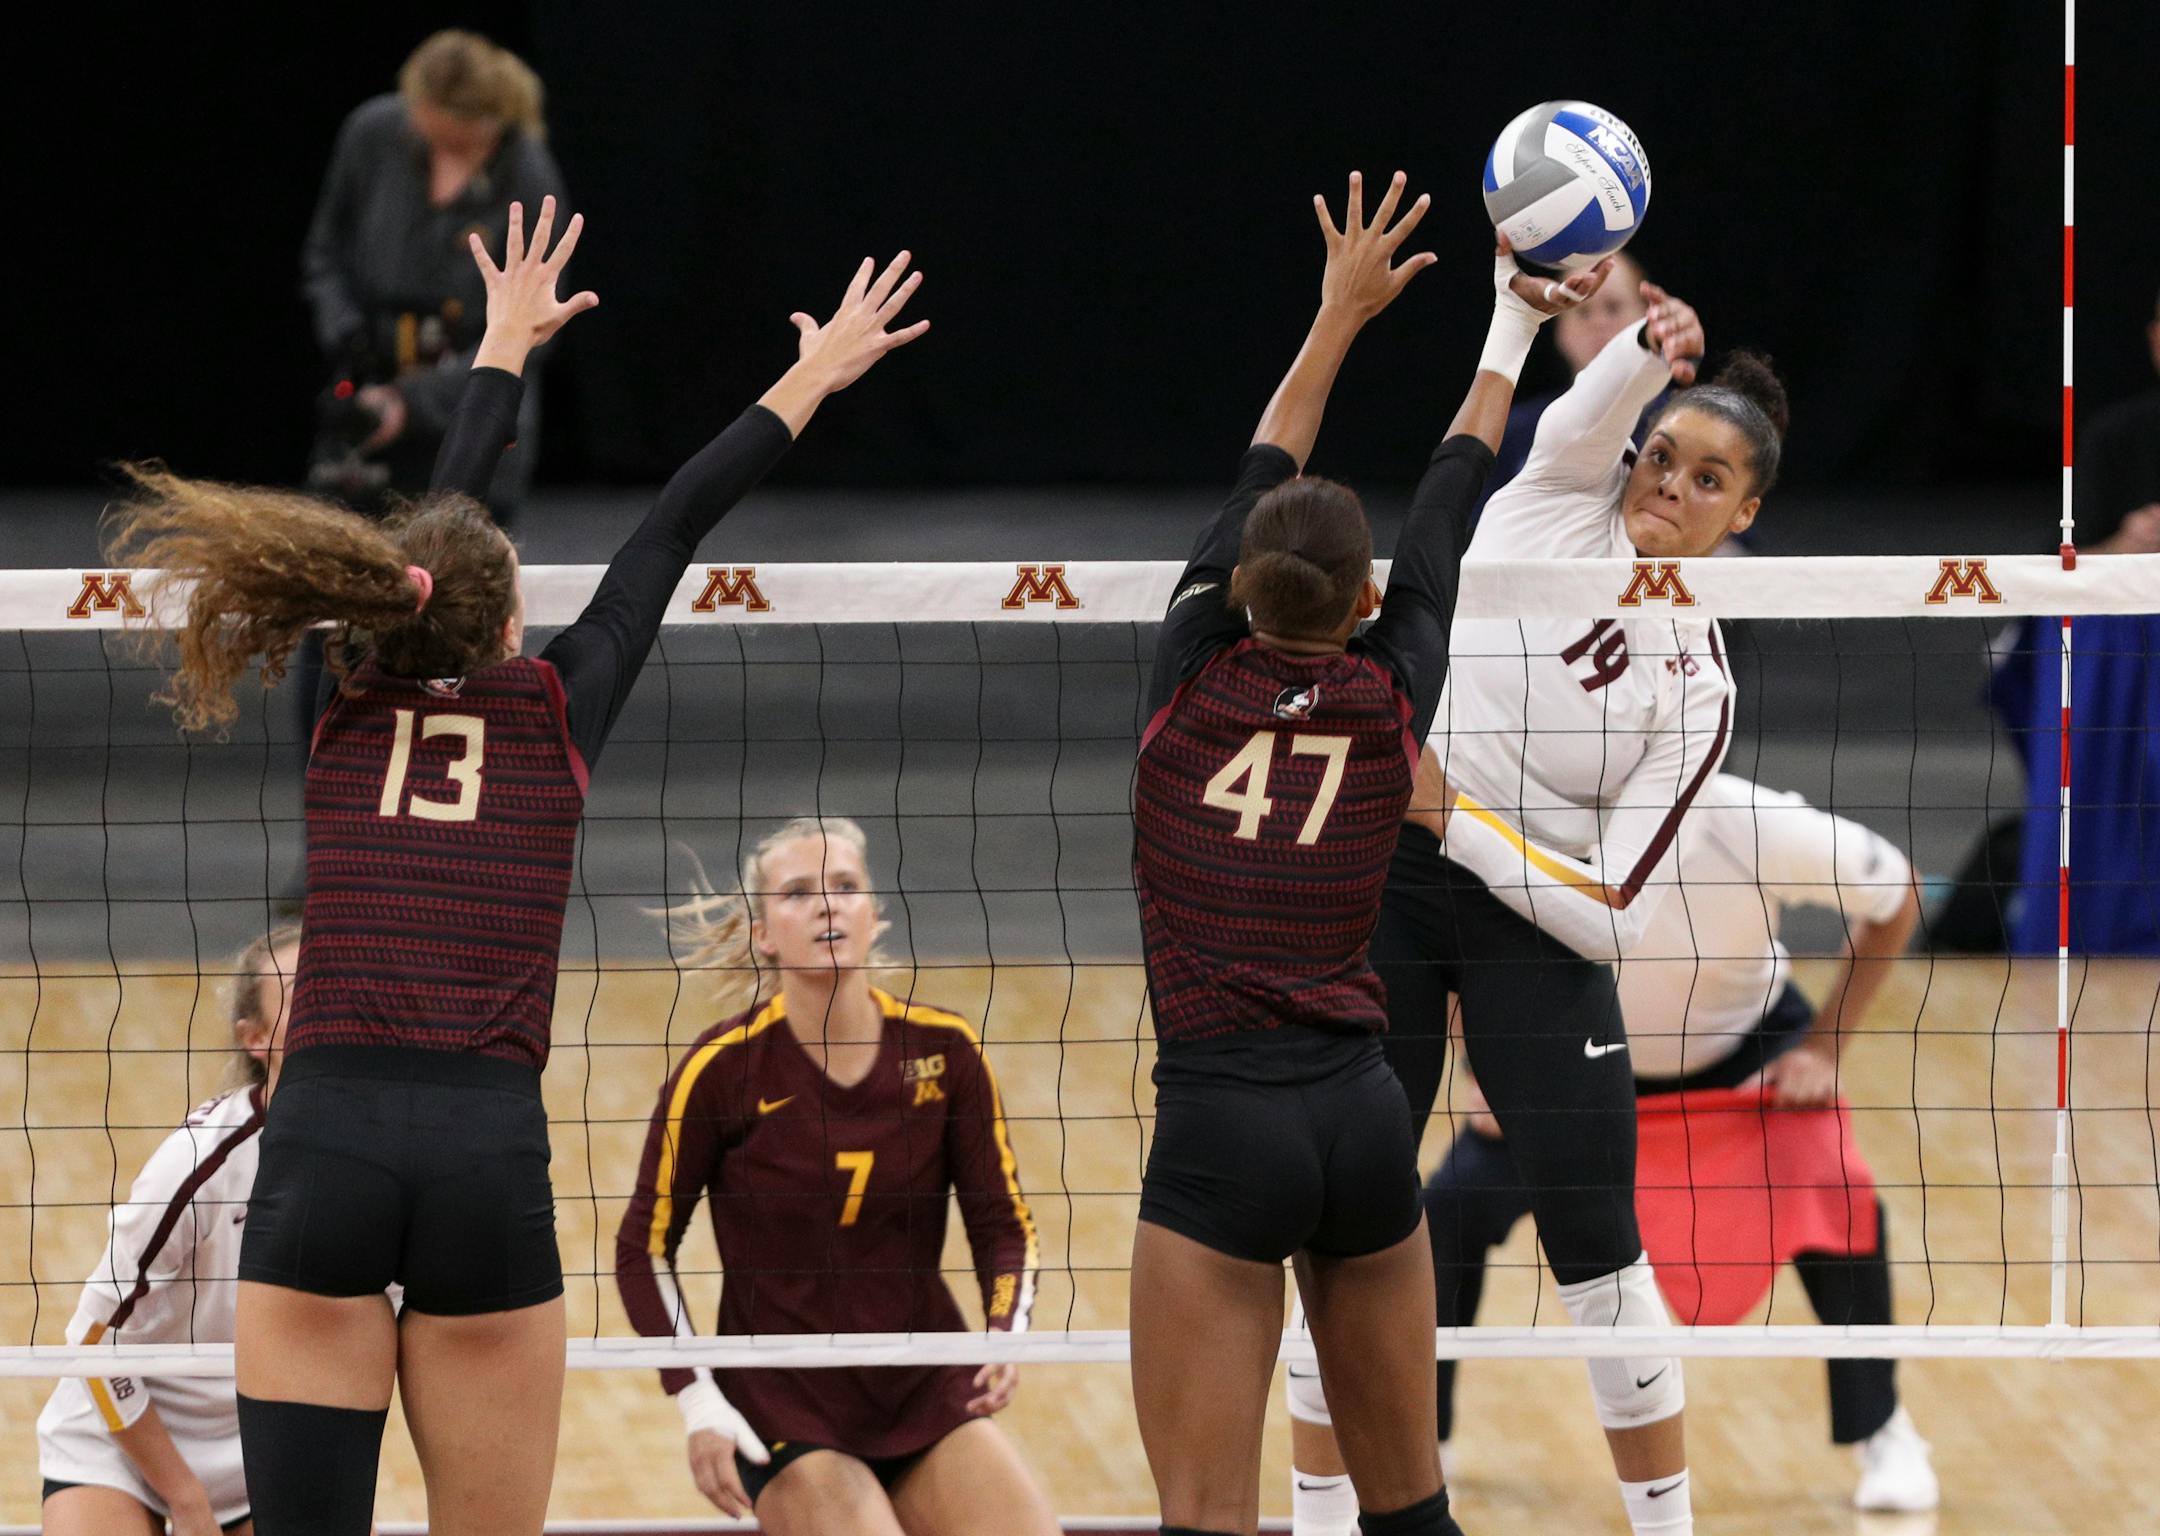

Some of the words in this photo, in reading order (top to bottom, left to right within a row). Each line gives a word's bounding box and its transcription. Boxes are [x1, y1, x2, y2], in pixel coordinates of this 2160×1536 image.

[1565, 143, 1597, 174] Super
[1599, 176, 1626, 212] Touch
[1585, 123, 1644, 191] NCAA
[67, 573, 146, 618] M
[692, 567, 770, 612] M
[1001, 564, 1079, 609] M
[1618, 561, 1695, 606] M
[1924, 558, 2001, 604] M
[1560, 618, 1630, 693] 19
[379, 709, 485, 822] 13
[1202, 730, 1352, 845] 47
[835, 1151, 875, 1227] 7
